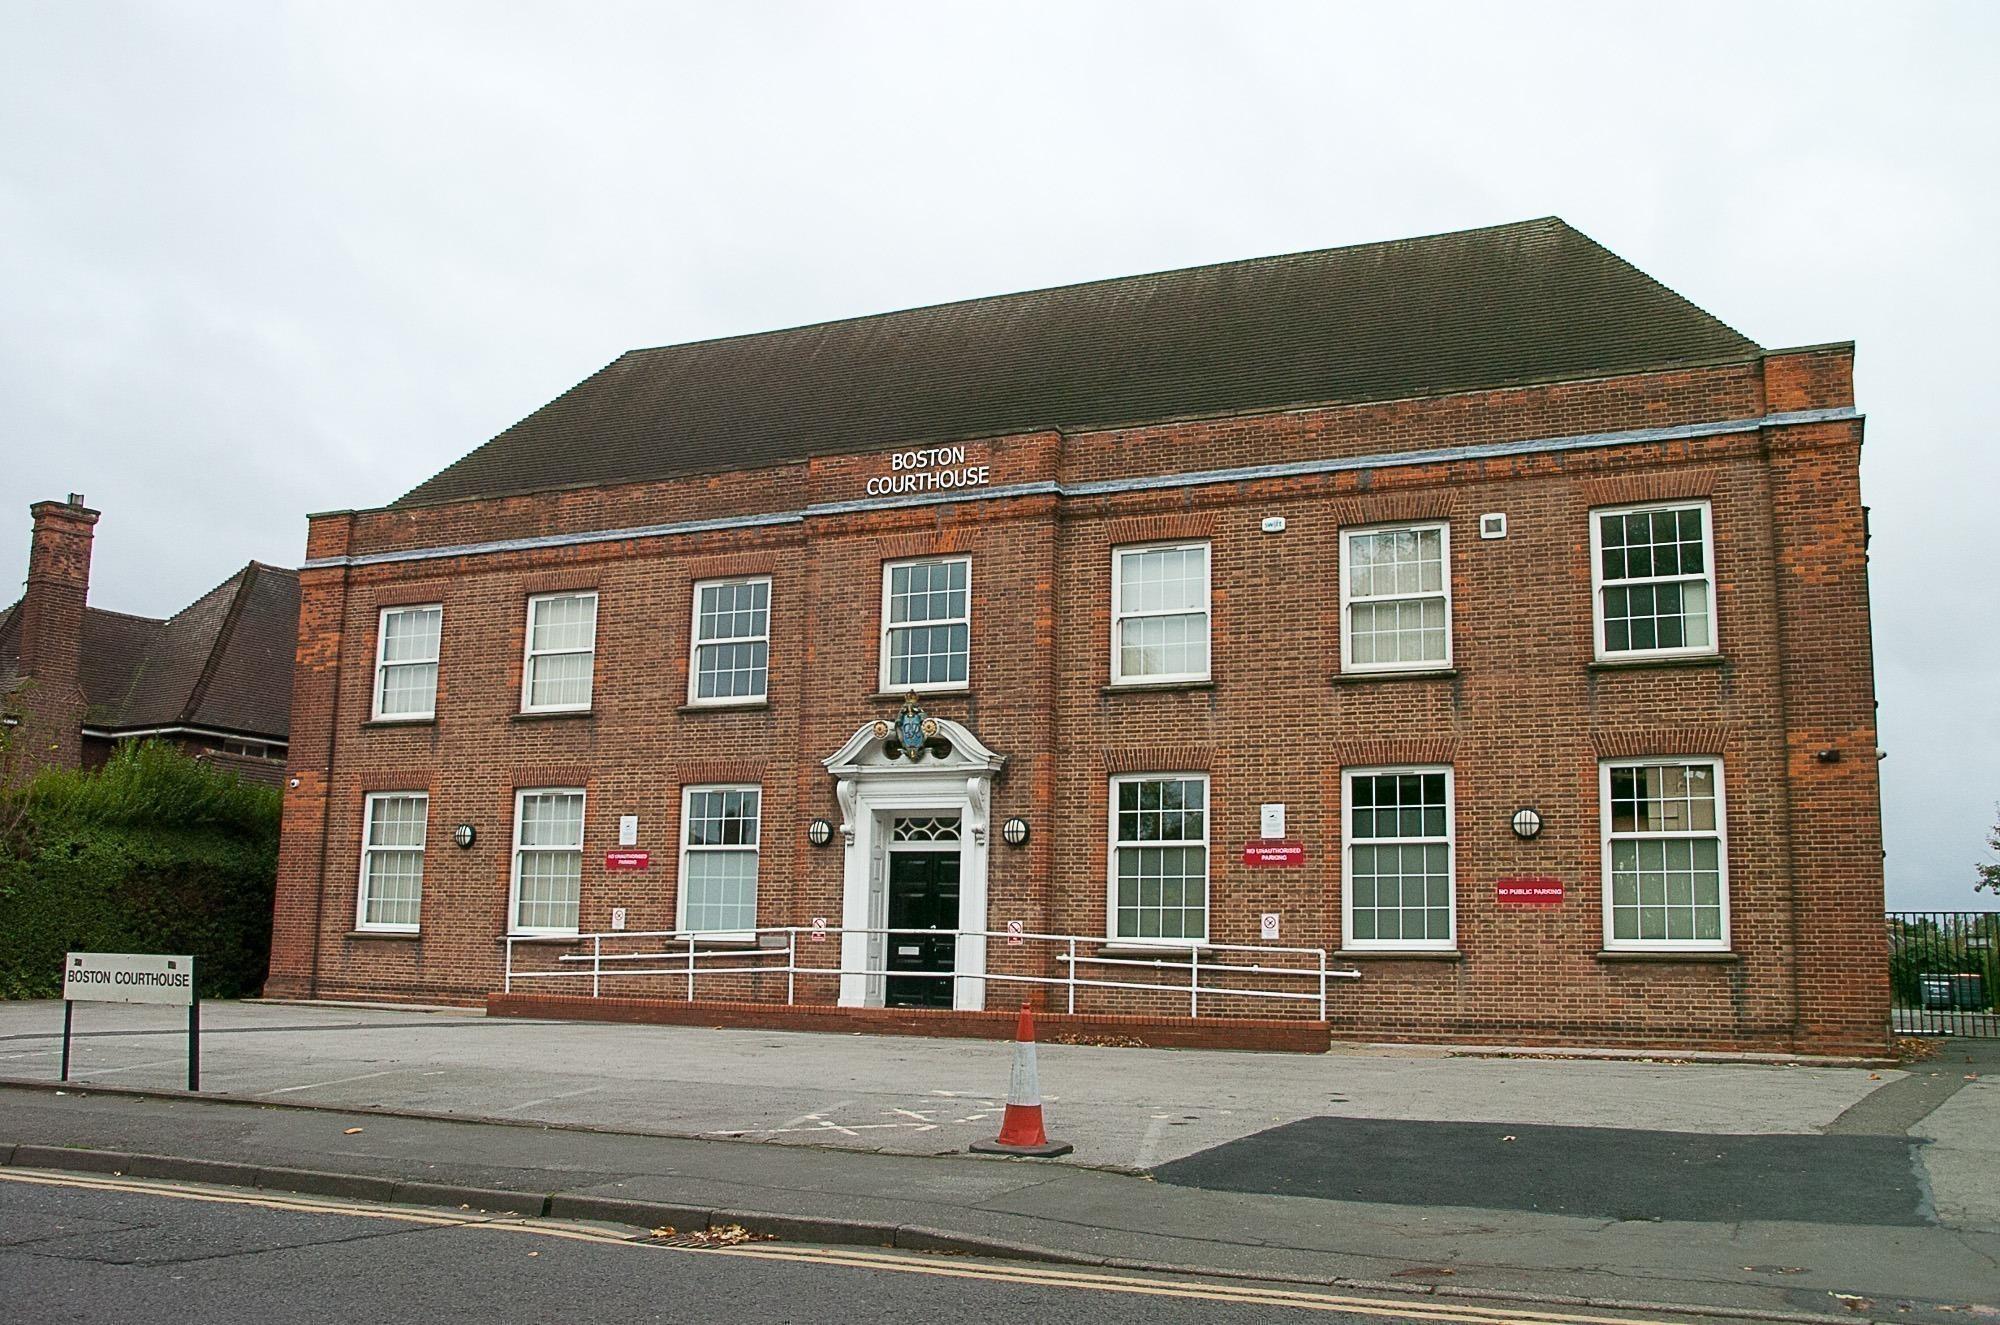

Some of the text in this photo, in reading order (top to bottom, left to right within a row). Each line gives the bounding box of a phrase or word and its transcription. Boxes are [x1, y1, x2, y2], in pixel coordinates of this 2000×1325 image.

[892, 446, 965, 471] BOSTON
[866, 466, 990, 495] COURTHOUSE
[68, 970, 190, 987] BOSTON COURTHOUSE
